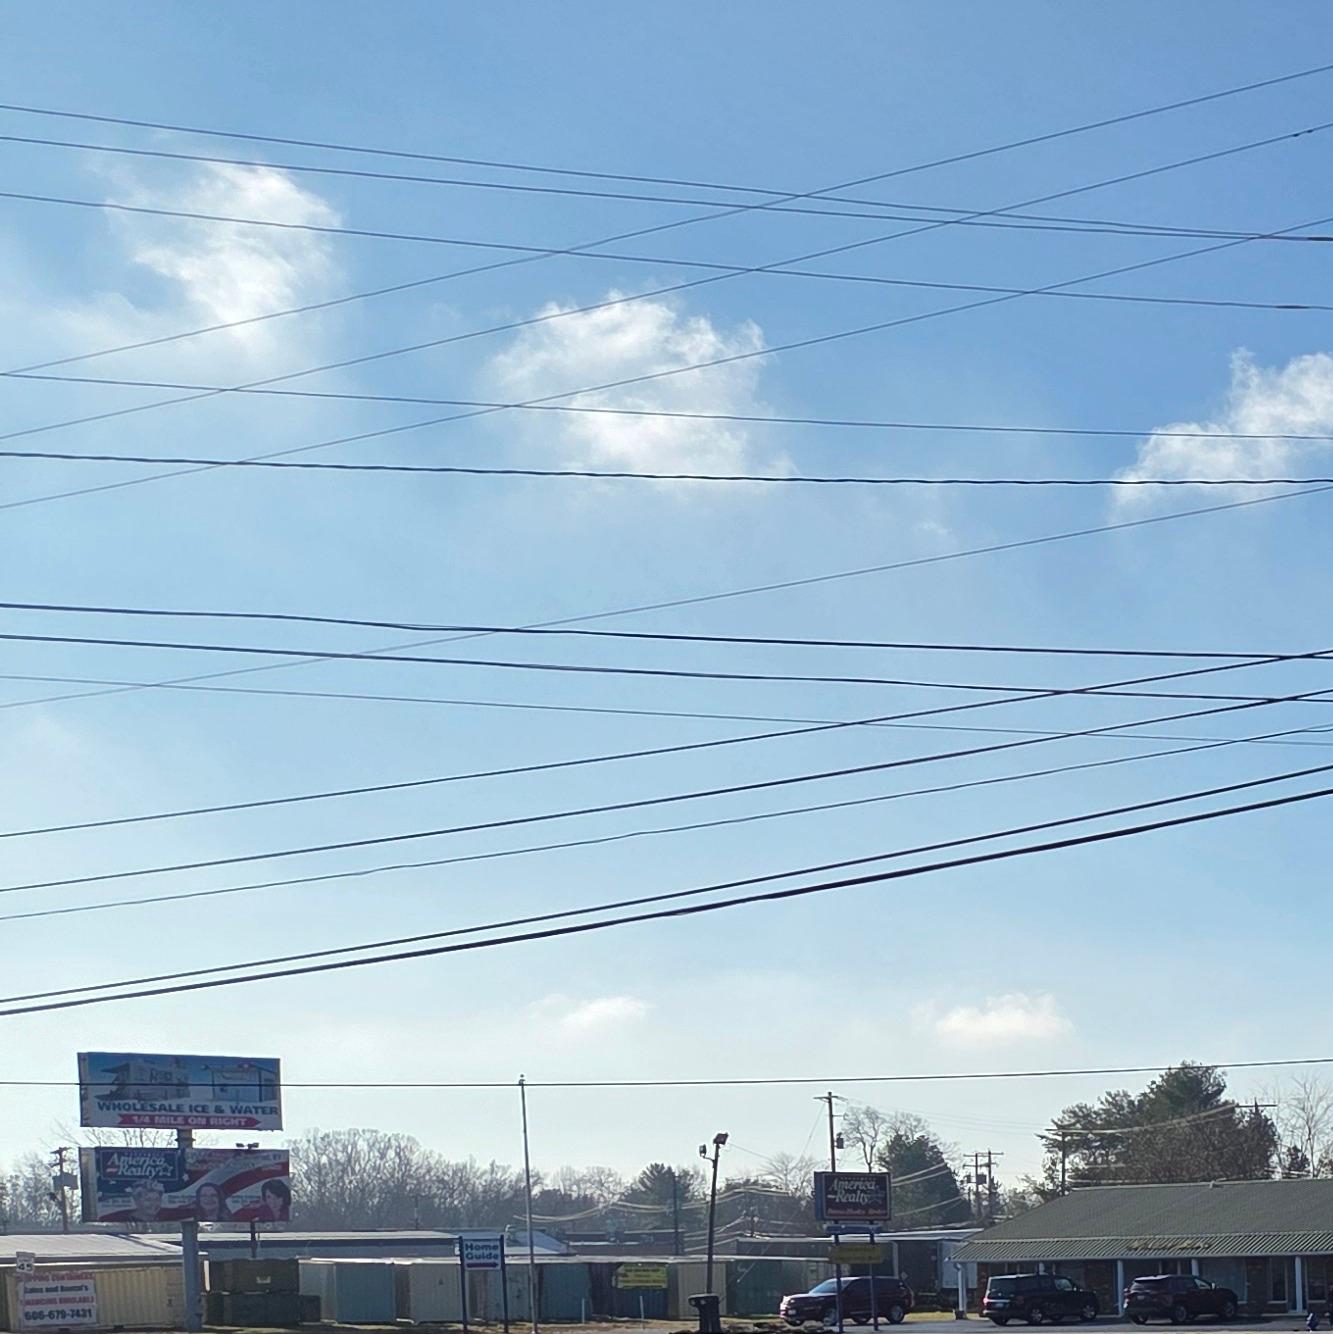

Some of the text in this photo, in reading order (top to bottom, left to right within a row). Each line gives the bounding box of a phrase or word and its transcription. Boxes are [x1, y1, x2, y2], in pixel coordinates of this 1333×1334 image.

[97, 1102, 279, 1115] WHOLESALE ICE & WATER
[132, 1115, 248, 1126] 1/4 MILE ON RIGHT
[107, 1152, 166, 1166] America
[118, 1164, 159, 1178] Realty
[828, 1177, 876, 1191] America
[835, 1189, 870, 1206] Realty
[465, 1242, 499, 1251] Home
[465, 1252, 499, 1260] Guide
[18, 1263, 33, 1272] 45
